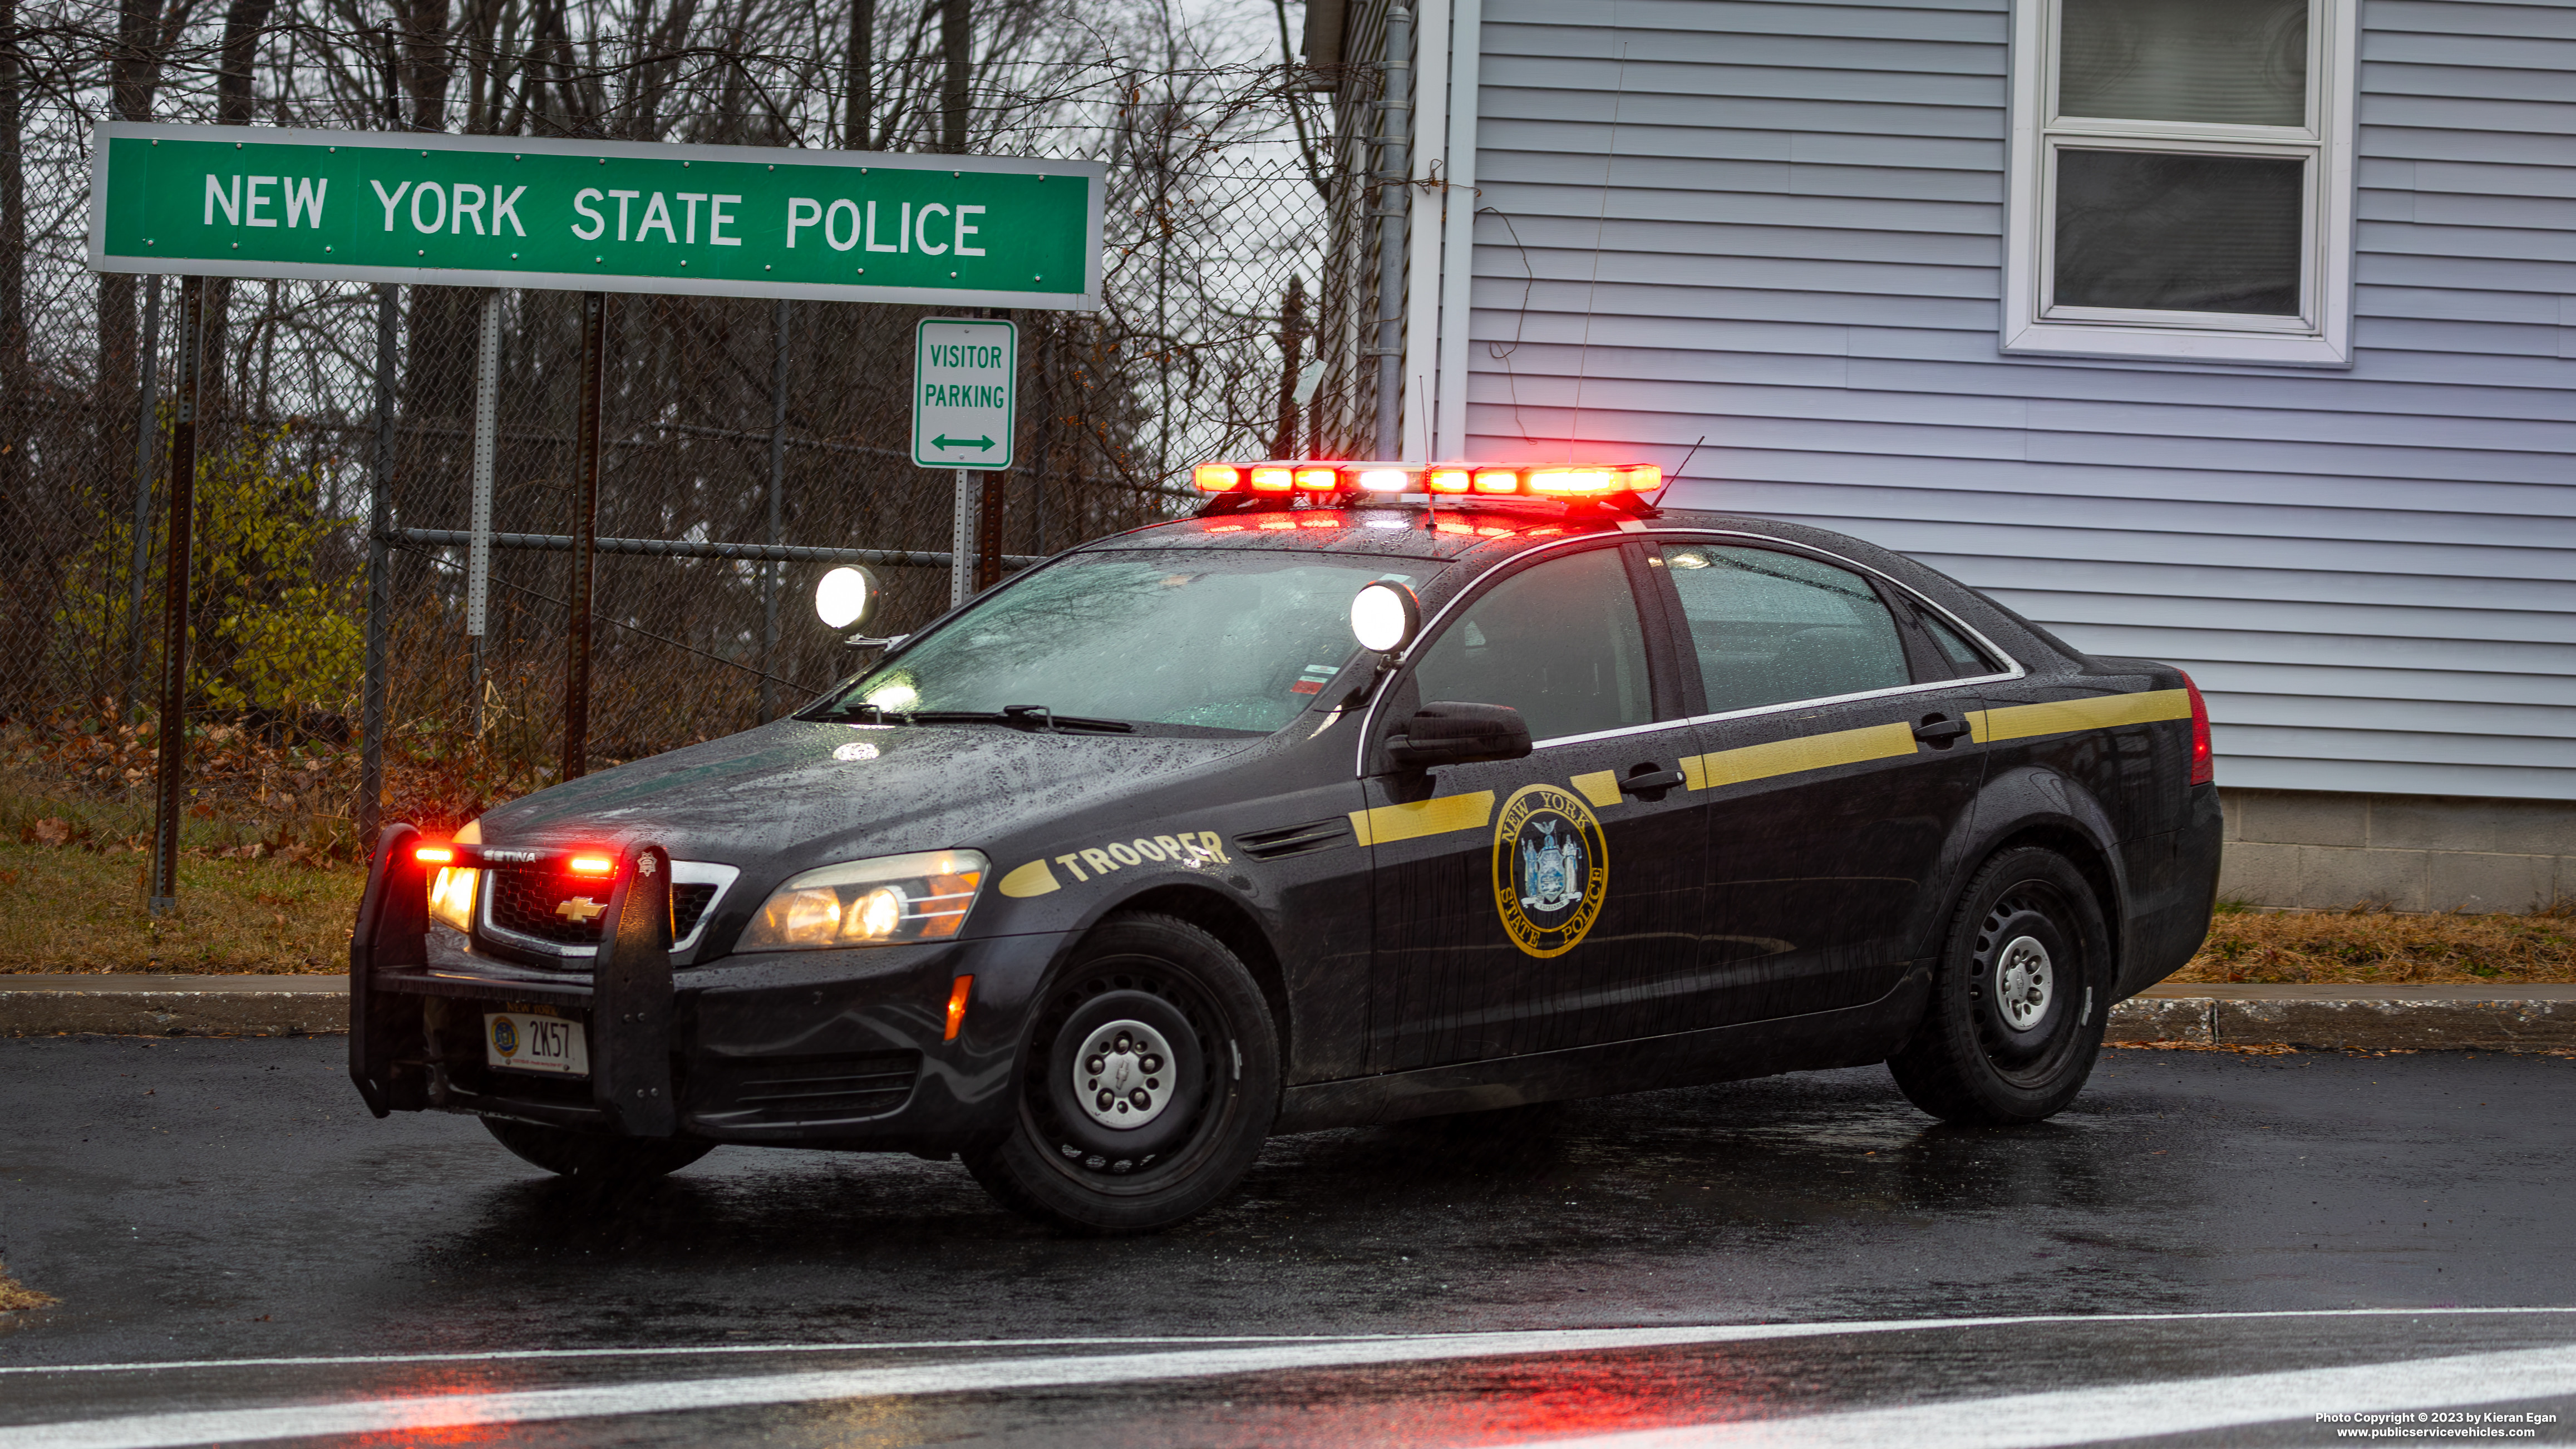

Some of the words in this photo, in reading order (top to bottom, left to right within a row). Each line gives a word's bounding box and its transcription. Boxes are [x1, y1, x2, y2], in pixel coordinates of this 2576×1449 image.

[205, 174, 327, 228] NEW
[370, 180, 527, 236] YORK
[571, 188, 741, 245] STATE
[787, 198, 985, 256] POLICE
[930, 344, 1002, 368] VISITOR
[925, 384, 1004, 408] PARKING
[1501, 797, 1529, 845] NEW
[1539, 791, 1590, 832] YORK
[483, 850, 536, 862] SETINA
[1055, 831, 1229, 882] TROOPER
[1500, 887, 1540, 948] STATE
[1562, 868, 1603, 944] POLICE
[506, 1002, 530, 1013] NEW
[530, 1020, 569, 1058] 2K57
